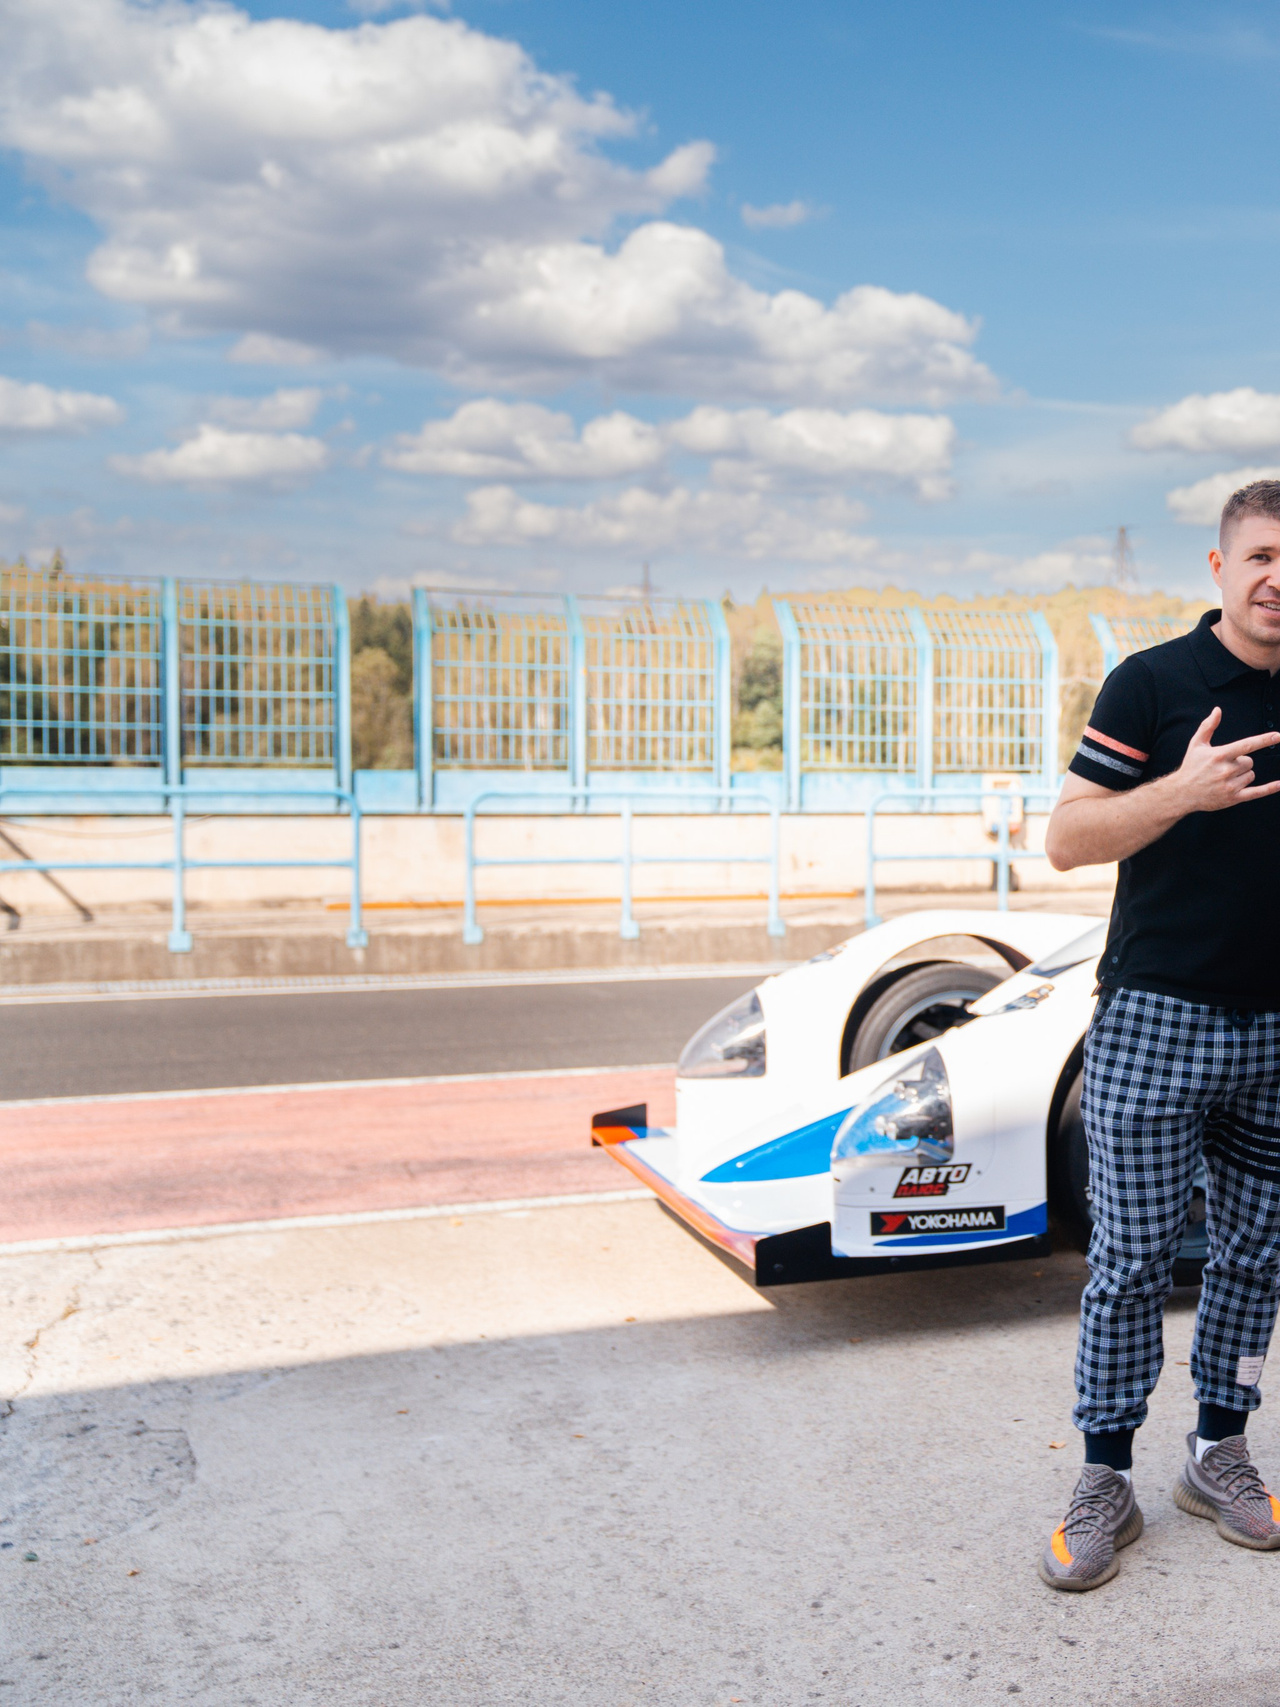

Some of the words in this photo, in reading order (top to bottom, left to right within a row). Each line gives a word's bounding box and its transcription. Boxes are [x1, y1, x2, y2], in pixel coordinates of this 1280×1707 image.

[900, 1165, 969, 1185] АВТО
[896, 1183, 945, 1196] ПЛЮС
[907, 1211, 997, 1230] YOKOHAMA
